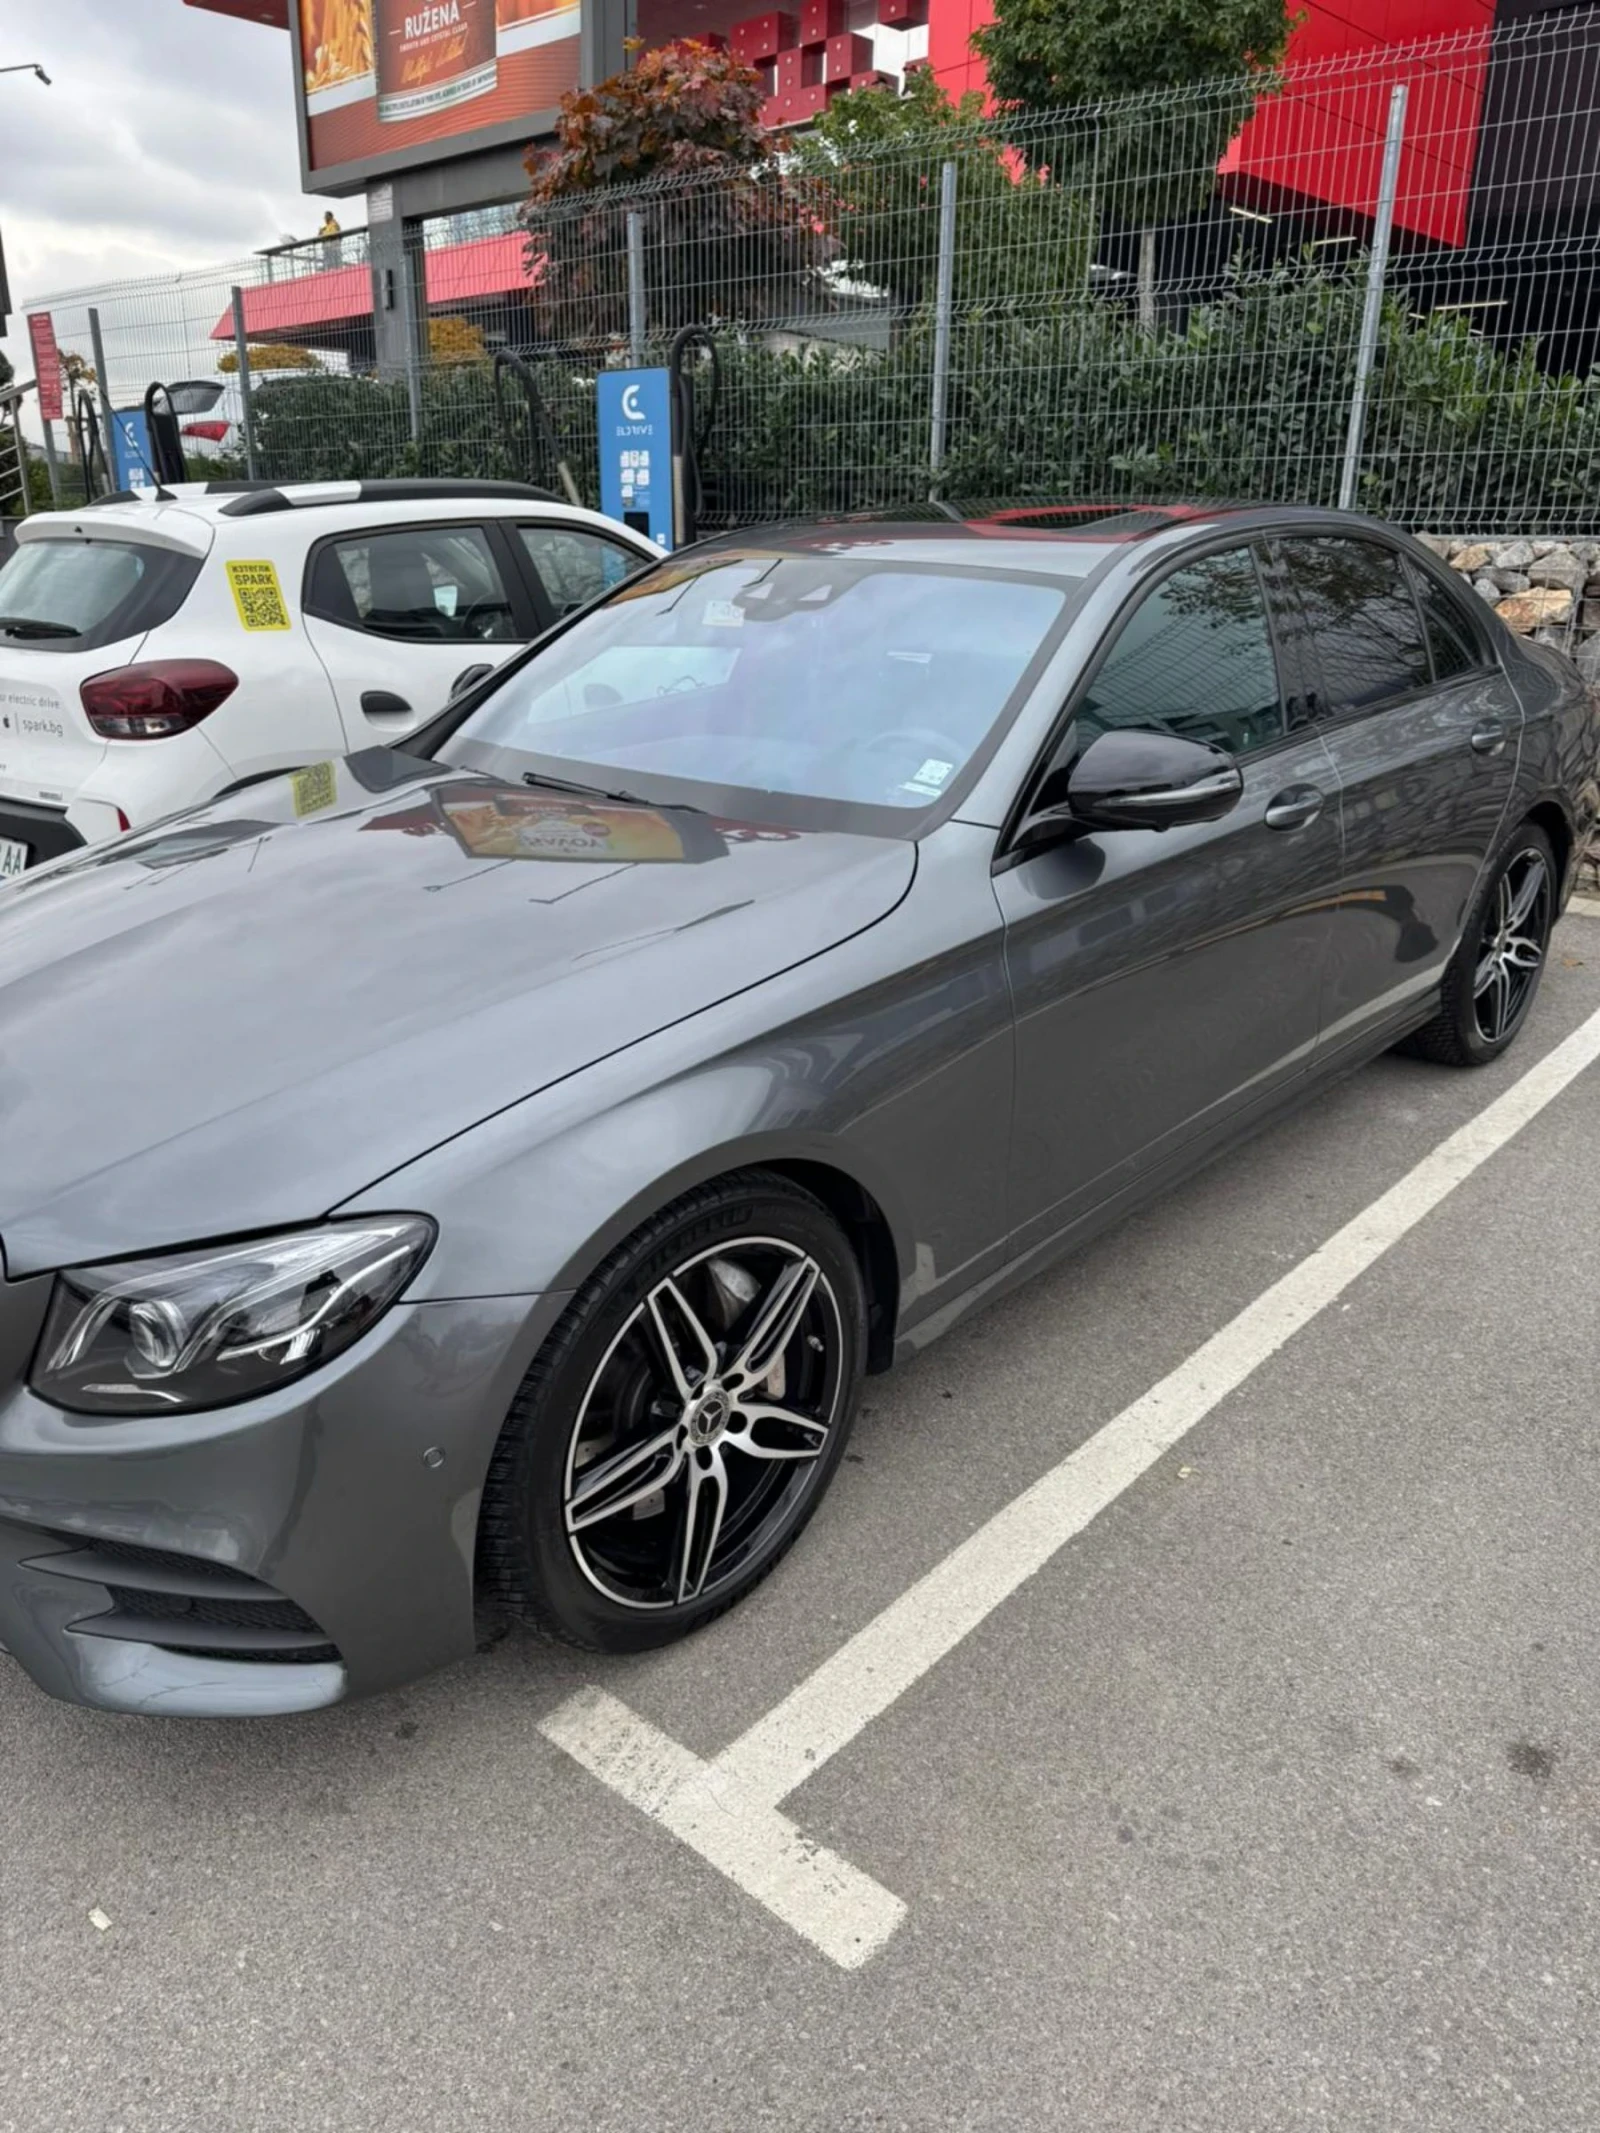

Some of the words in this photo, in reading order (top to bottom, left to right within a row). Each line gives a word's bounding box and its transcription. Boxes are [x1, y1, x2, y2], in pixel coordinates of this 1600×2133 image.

[404, 1, 460, 39] RUŽENA
[234, 574, 274, 585] SPARK
[8, 693, 37, 706] electric
[38, 696, 60, 709] drive
[22, 718, 63, 738] spark.bg
